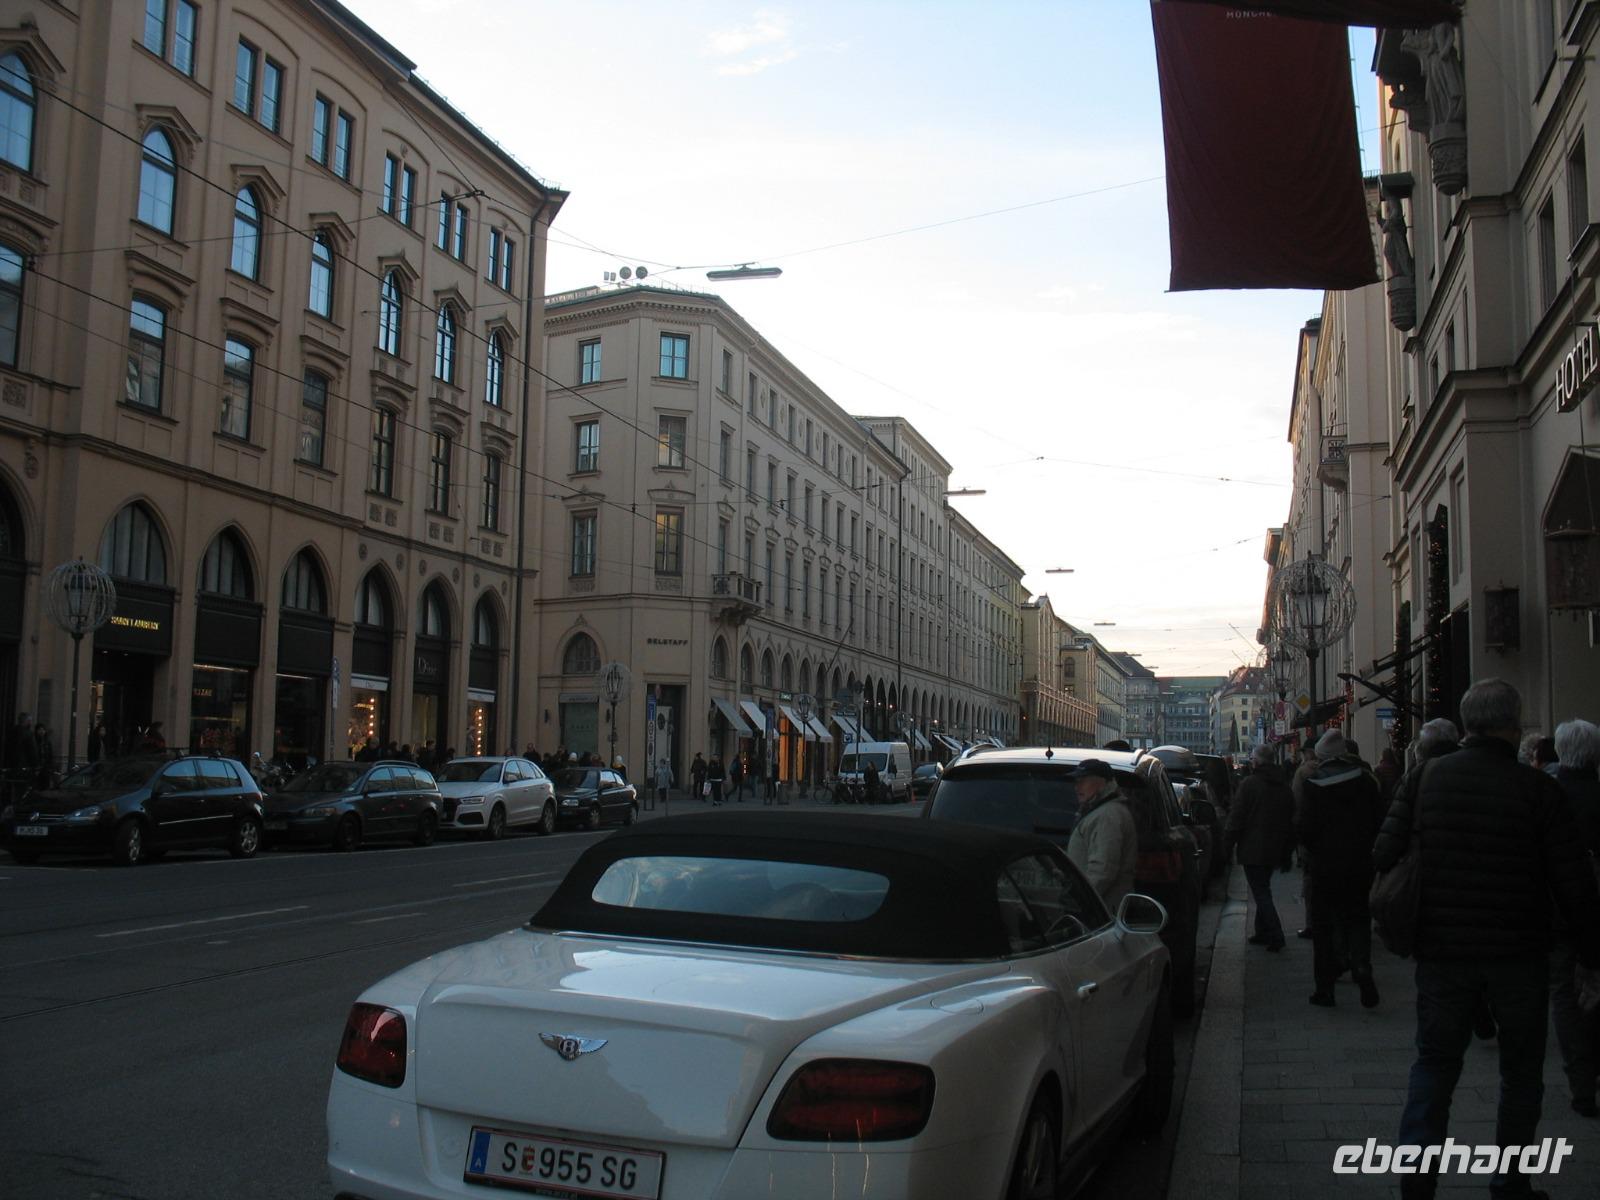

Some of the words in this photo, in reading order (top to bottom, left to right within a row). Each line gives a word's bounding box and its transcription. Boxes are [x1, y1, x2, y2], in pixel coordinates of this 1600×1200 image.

[1555, 325, 1598, 414] HOTEL
[502, 1141, 518, 1172] S
[538, 1147, 594, 1184] 955
[600, 1155, 637, 1190] SG
